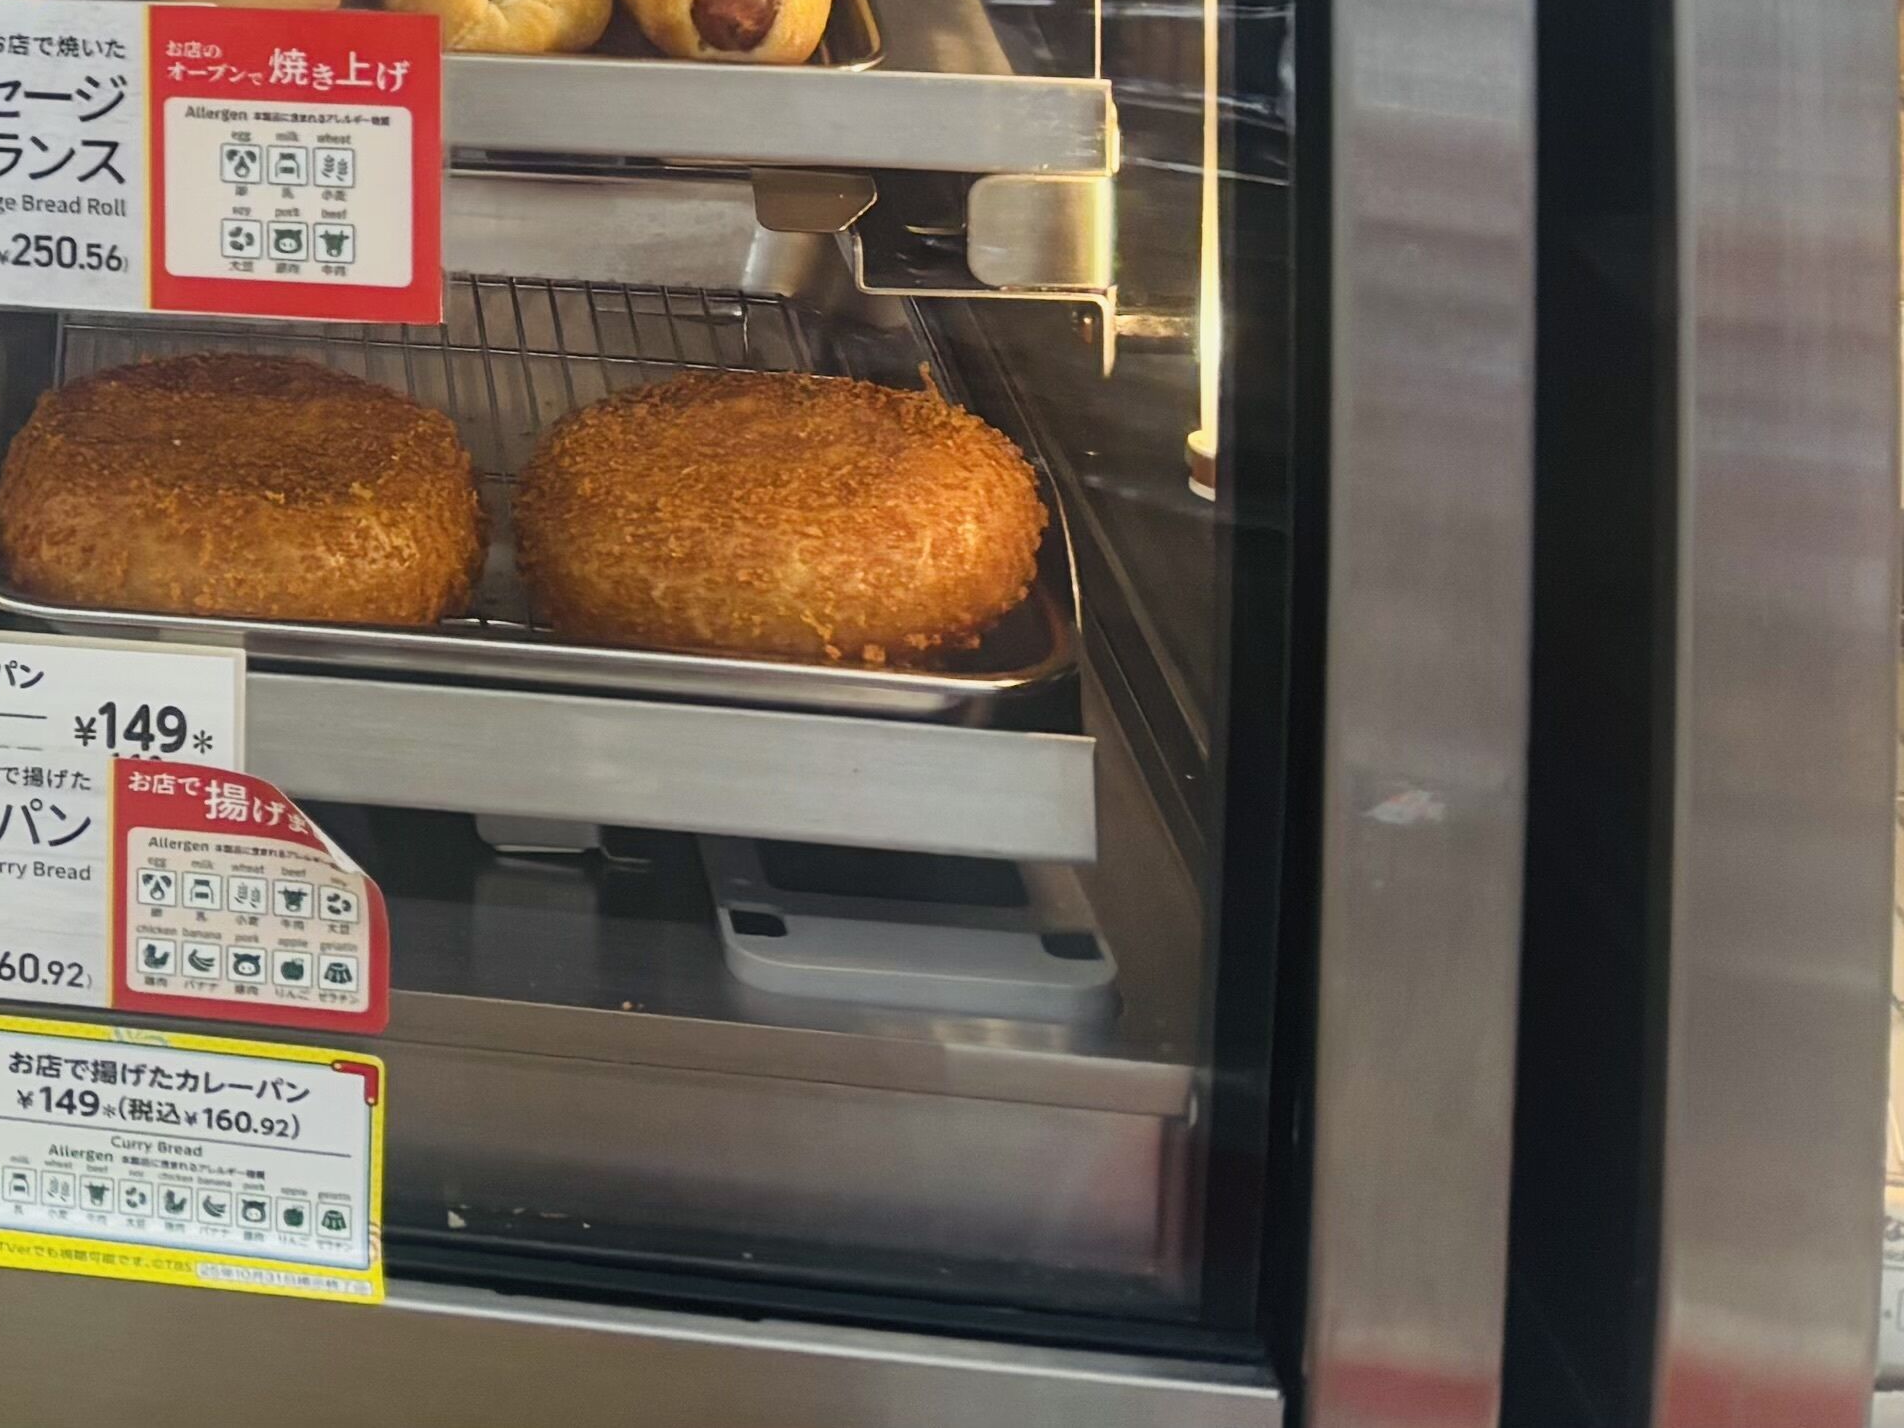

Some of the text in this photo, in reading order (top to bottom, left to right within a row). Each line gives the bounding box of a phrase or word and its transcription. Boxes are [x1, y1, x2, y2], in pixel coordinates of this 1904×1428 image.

[166, 40, 222, 59] お店の
[168, 47, 410, 93] オーブンで 焼き上げ
[22, 194, 82, 217] Bread
[88, 196, 128, 217] Roll
[128, 771, 202, 797] お店で
[149, 835, 210, 853] Allergen
[32, 859, 91, 882] Bread
[8, 1051, 311, 1105] お店で揚げたカレーパン
[49, 1143, 114, 1163] Allergen
[110, 1135, 203, 1158] Curry Bread
